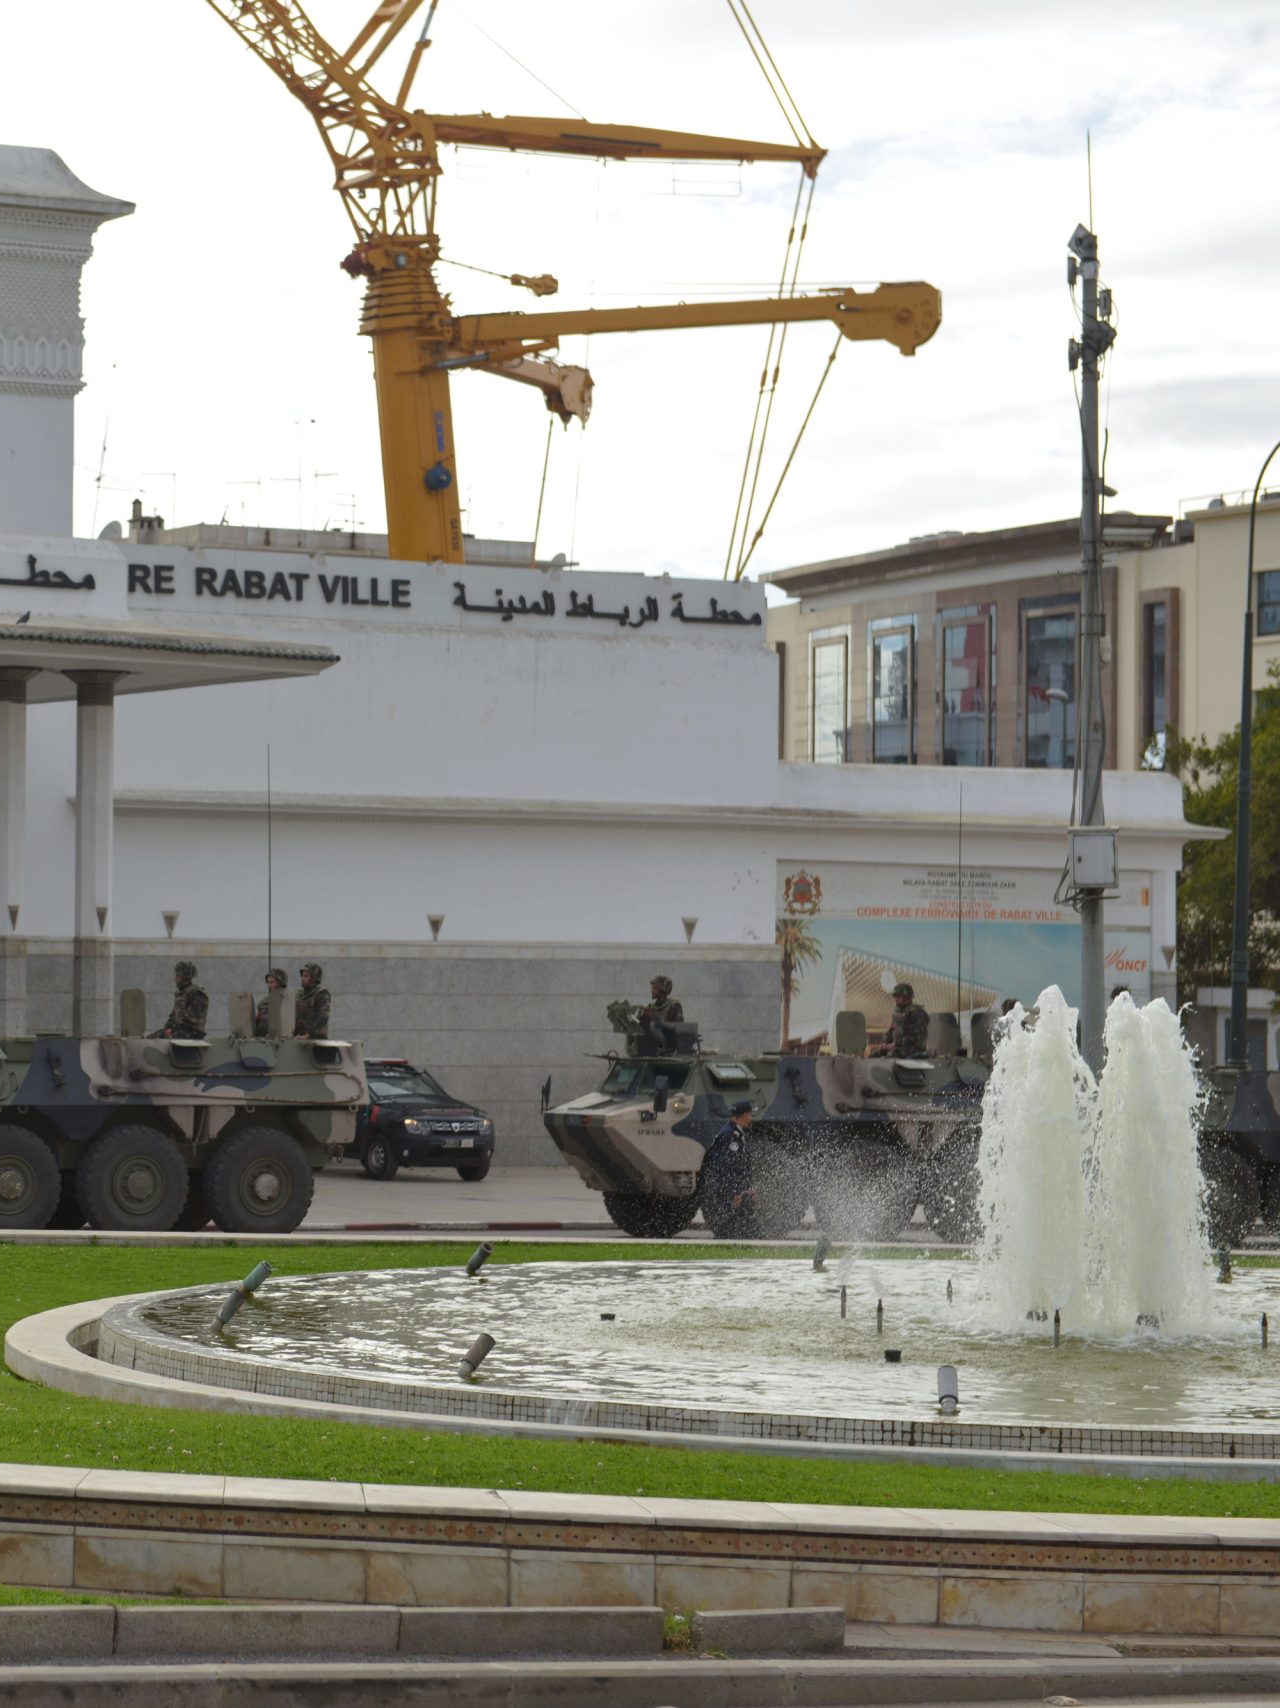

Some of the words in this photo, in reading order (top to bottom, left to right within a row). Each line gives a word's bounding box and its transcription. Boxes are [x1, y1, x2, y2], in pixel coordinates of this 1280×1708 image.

[128, 564, 175, 594] RE
[195, 567, 310, 601] RABAT
[318, 574, 412, 608] VILLE
[453, 581, 555, 622] المدينة
[566, 590, 659, 627] الرباط
[671, 592, 762, 626] محطة
[902, 879, 927, 887] WILAYA
[927, 871, 957, 879] ROYAUME
[857, 905, 913, 918] COMPLEXE
[914, 907, 981, 919] FERROVIAIRE
[983, 909, 996, 919] DE
[999, 910, 1032, 920] RABAT
[1036, 911, 1063, 920] VILLE
[1115, 960, 1147, 971] ONCF
